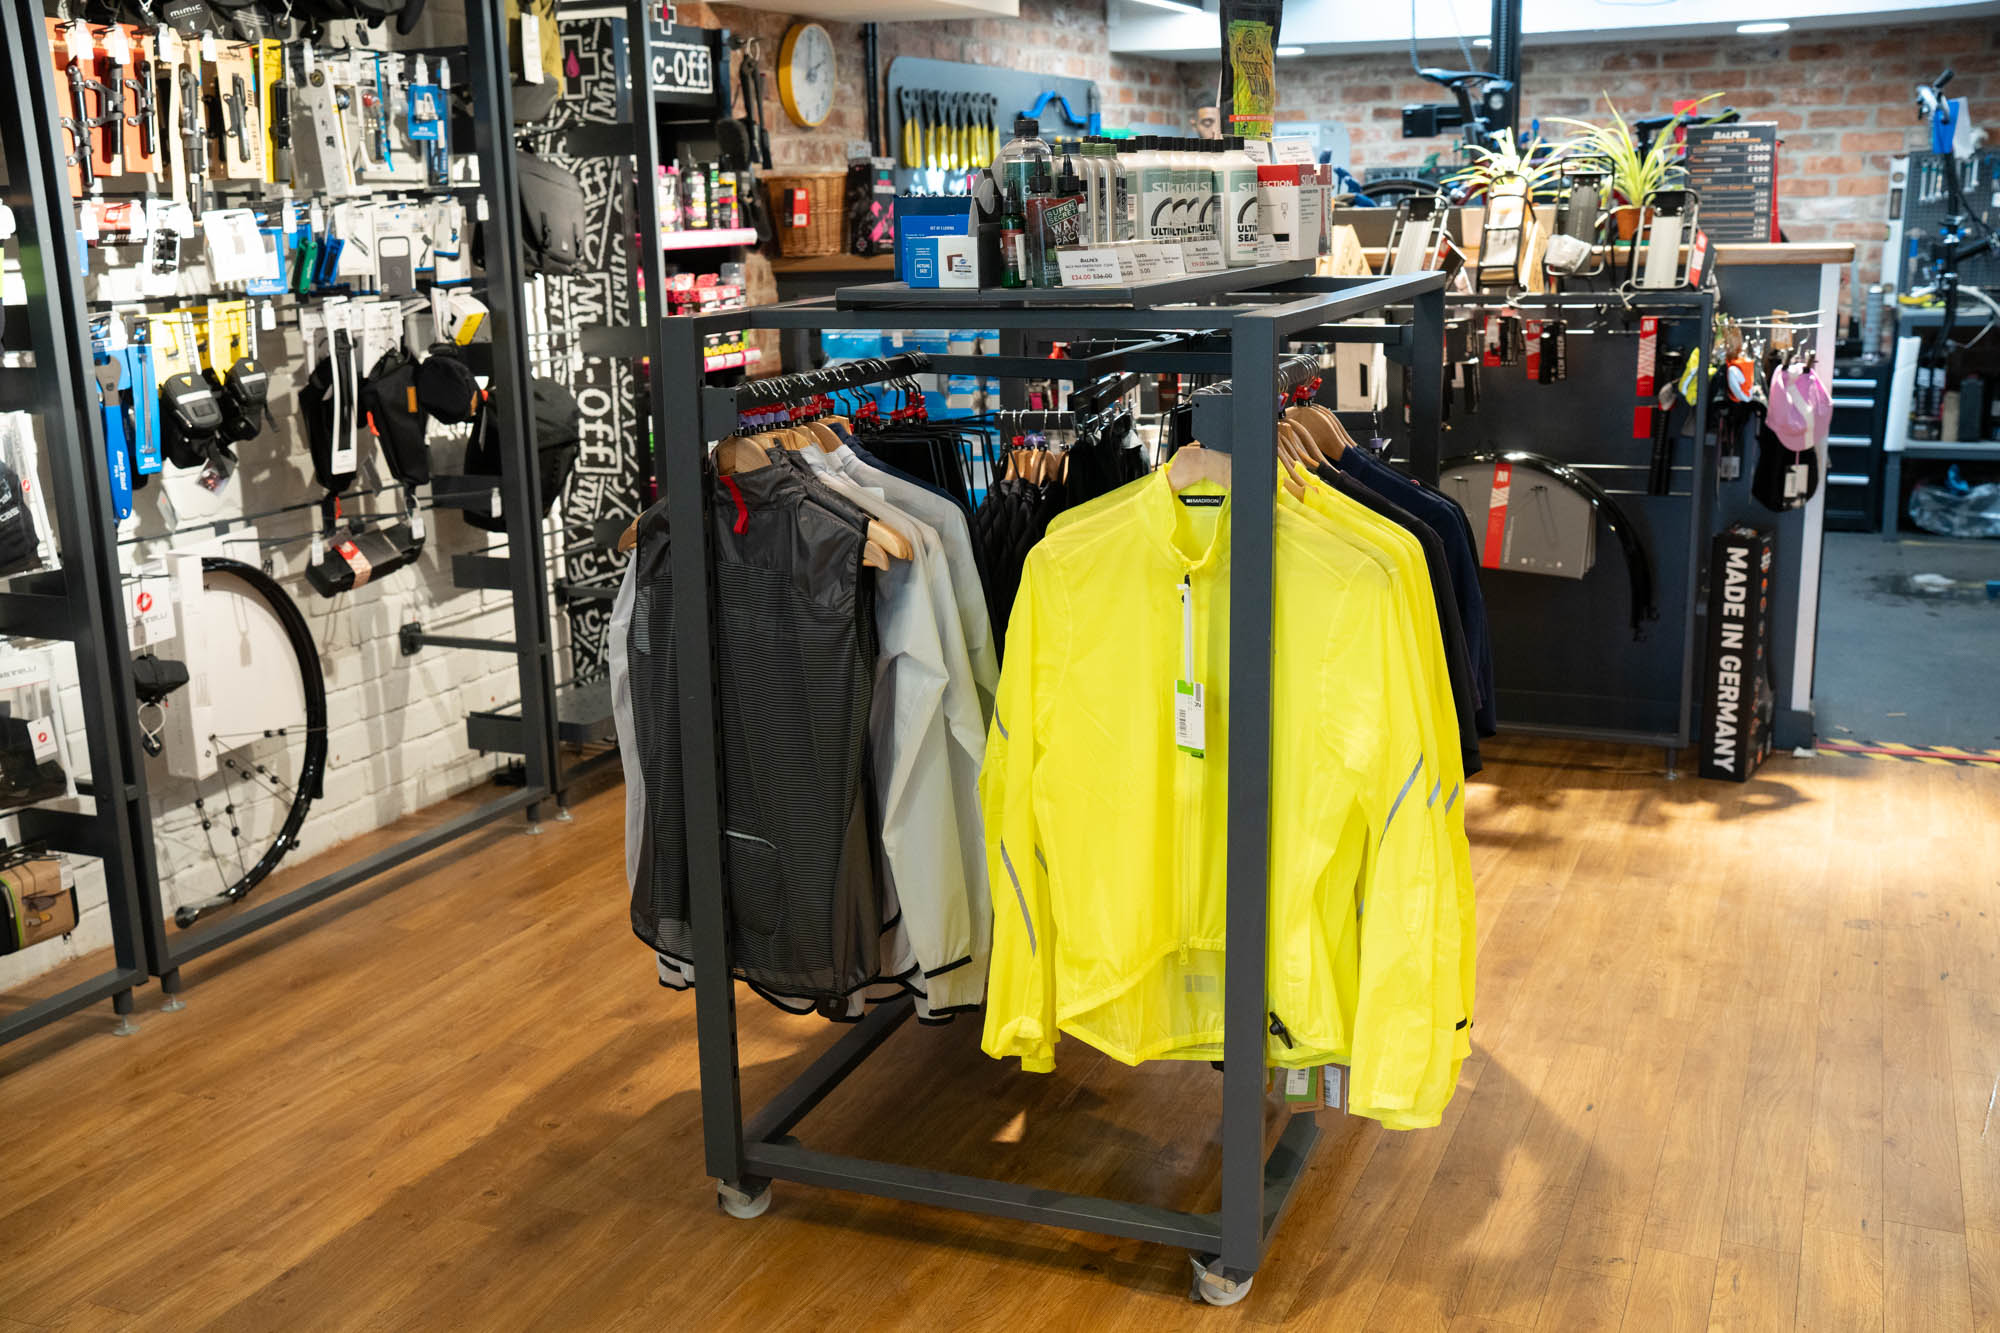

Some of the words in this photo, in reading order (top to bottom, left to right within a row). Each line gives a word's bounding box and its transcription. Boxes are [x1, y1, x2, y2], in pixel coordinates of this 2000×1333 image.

[1046, 202, 1076, 218] SUPER
[1048, 208, 1077, 225] SECRET
[1051, 215, 1079, 234] WAX
[1722, 547, 1749, 618] MADE
[1720, 622, 1745, 650] IN
[1712, 654, 1743, 774] GERMANY
